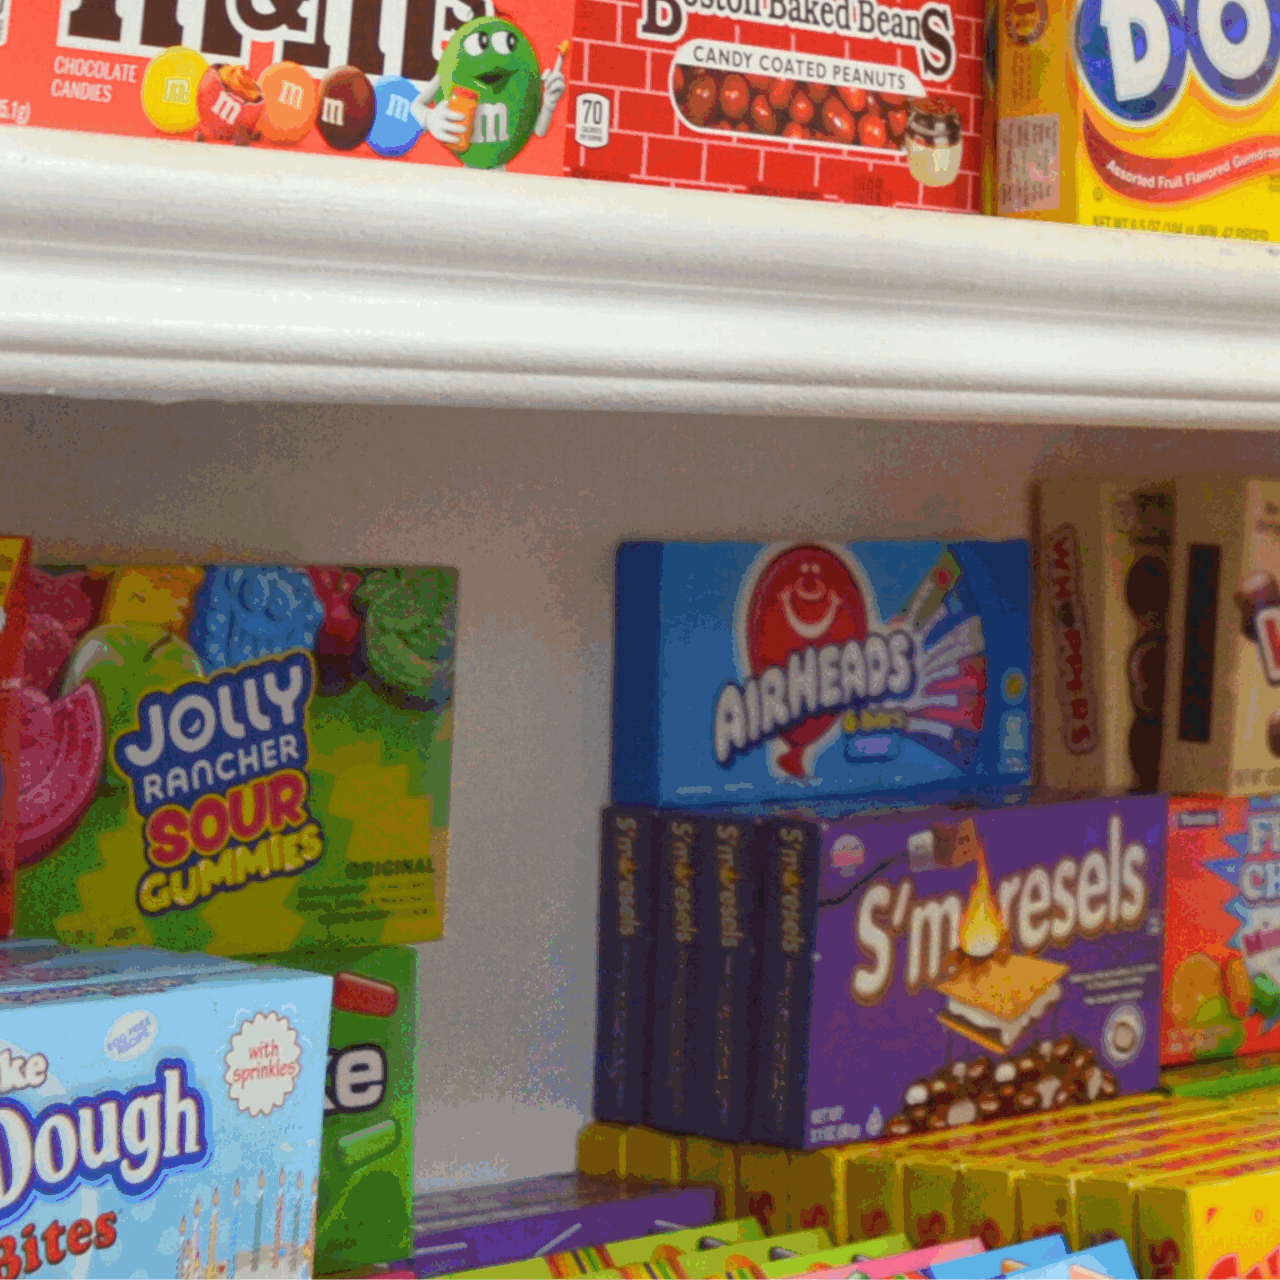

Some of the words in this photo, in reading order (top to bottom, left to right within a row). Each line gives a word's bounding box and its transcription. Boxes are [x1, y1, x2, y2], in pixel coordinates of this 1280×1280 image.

[53, 54, 139, 84] CHOCOLATE
[692, 44, 753, 69] CANDY
[758, 55, 827, 79] COATED
[831, 65, 907, 91] PEANUTS
[50, 77, 114, 104] CANDIES
[320, 96, 345, 126] m
[471, 102, 510, 143] m
[581, 98, 604, 126] 70
[1106, 159, 1156, 189] Assorted
[1156, 175, 1185, 190] Fruit
[1184, 159, 1232, 187] Flavored
[124, 664, 303, 767] JOLLY
[715, 631, 912, 763] AIRHEADS
[143, 733, 300, 804] RANCHER
[147, 770, 307, 867] SOUR
[138, 822, 323, 913] GUMMIES
[346, 858, 435, 879] ORIGINAL
[0, 1049, 48, 1093] ke
[247, 1040, 280, 1061] with
[233, 1060, 296, 1089] sprinkles
[0, 1067, 202, 1186] Dough
[0, 1210, 118, 1280] Bites
